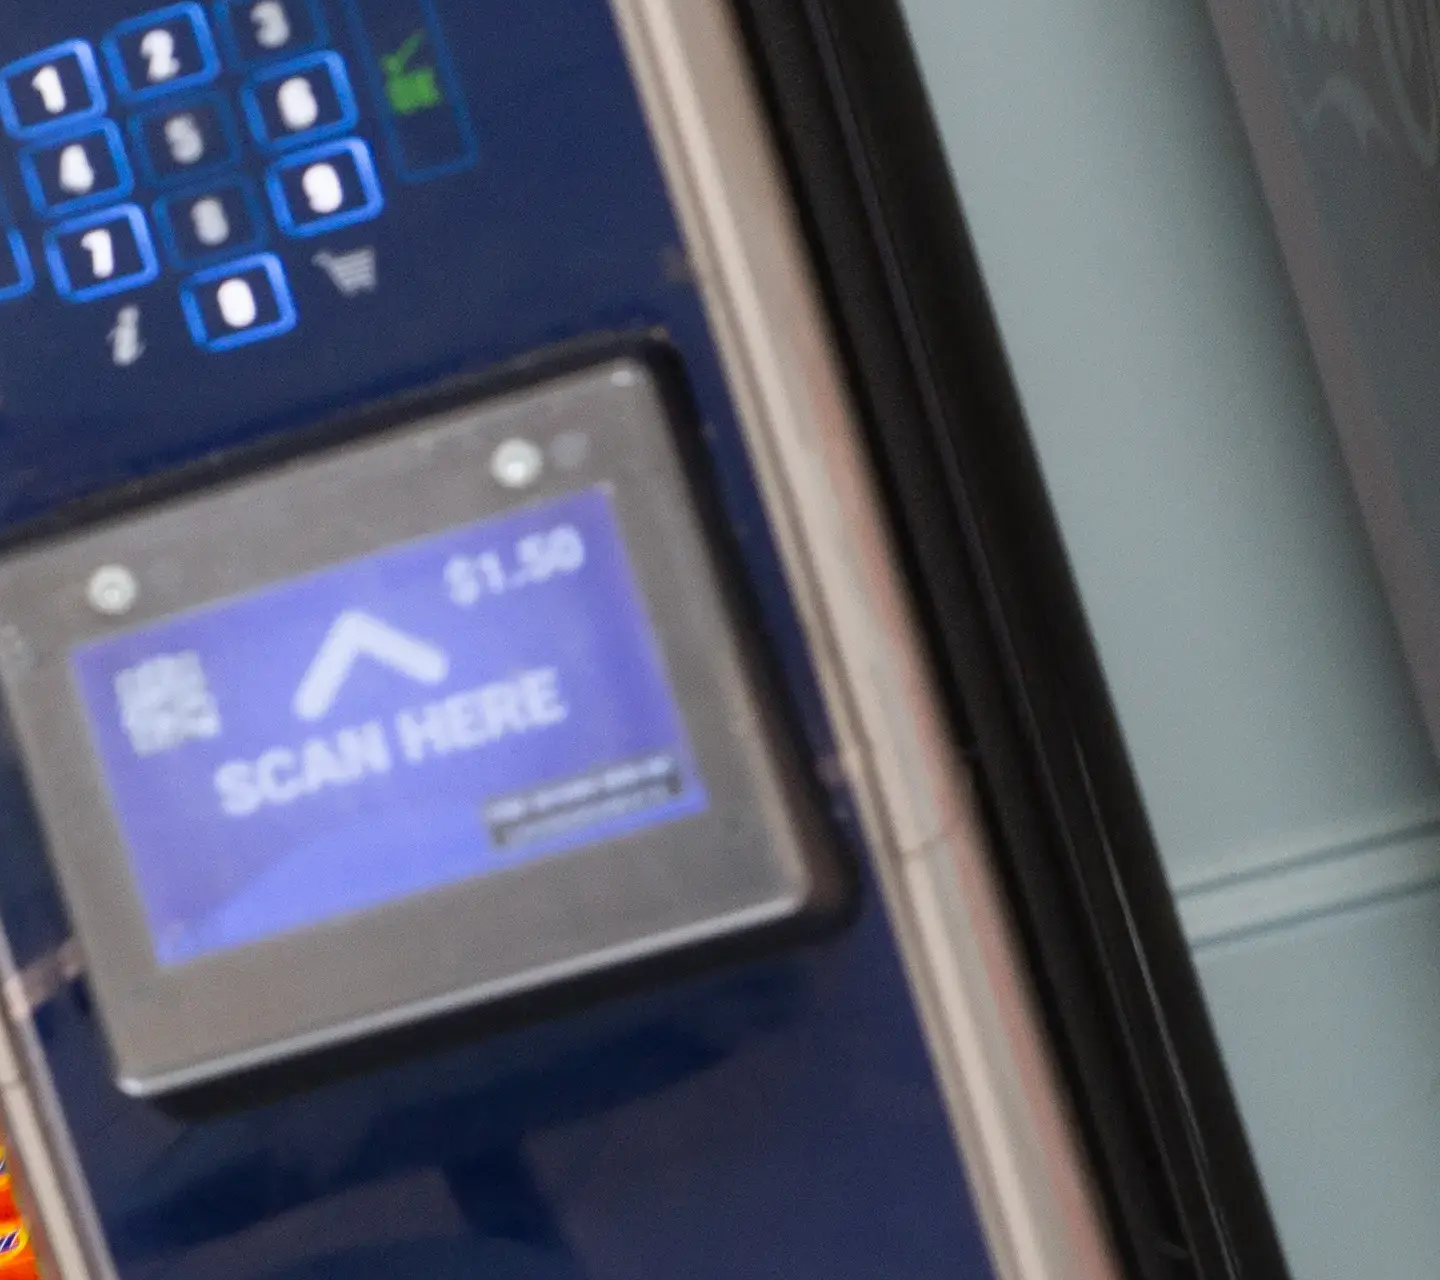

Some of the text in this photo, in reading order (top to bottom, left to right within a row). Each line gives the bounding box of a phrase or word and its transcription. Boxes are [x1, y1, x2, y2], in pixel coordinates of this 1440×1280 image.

[32, 66, 66, 114] 1
[141, 29, 180, 83] 2
[58, 144, 94, 194] 4
[81, 229, 114, 279] 7
[216, 278, 256, 328] 0
[443, 525, 584, 606] $1.50
[213, 726, 390, 817] SCAN
[396, 667, 566, 762] HERE
